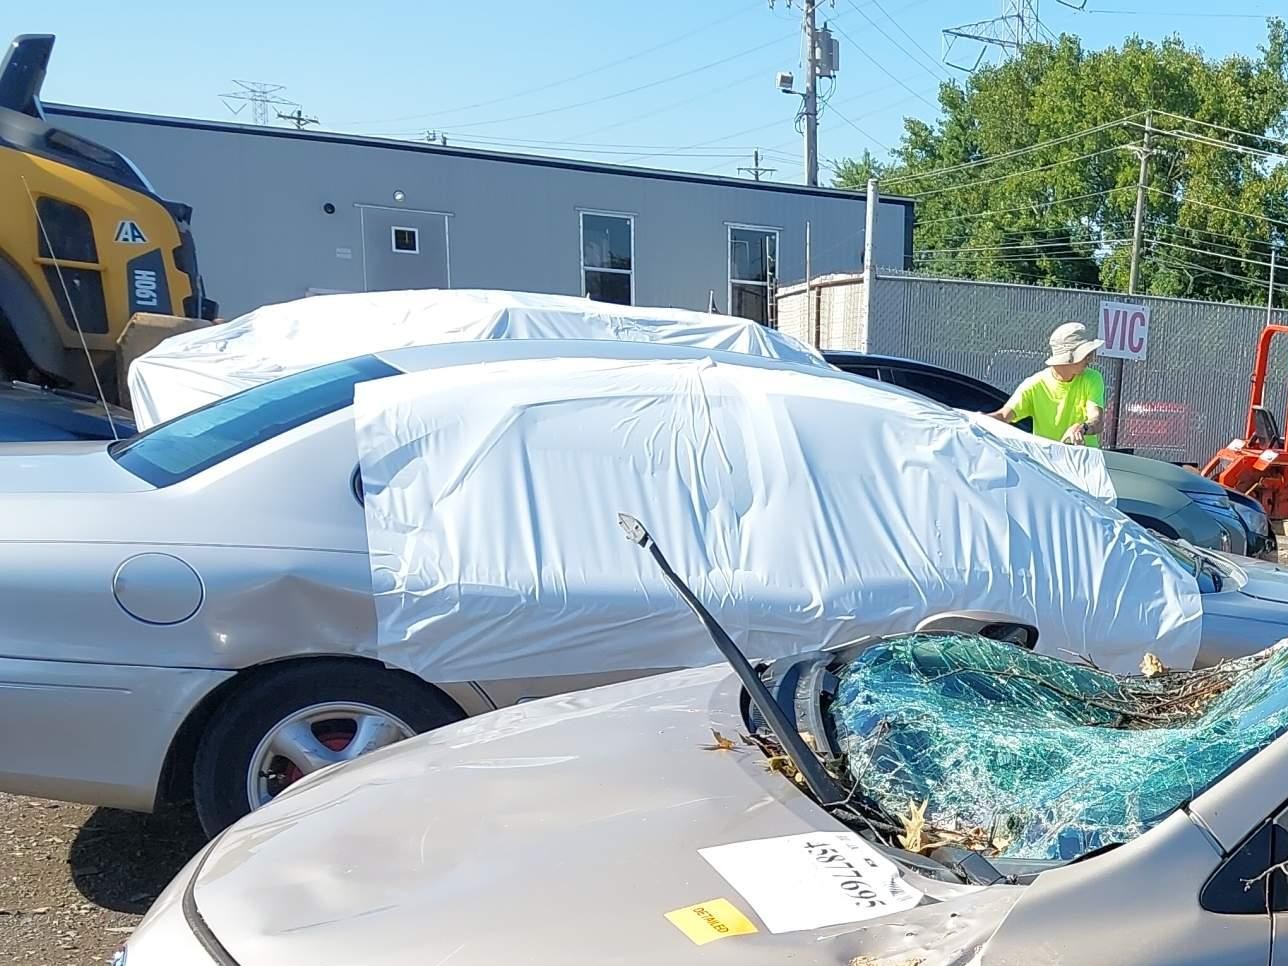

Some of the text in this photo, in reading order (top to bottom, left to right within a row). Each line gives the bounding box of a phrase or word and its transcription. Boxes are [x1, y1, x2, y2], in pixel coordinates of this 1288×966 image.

[134, 270, 157, 305] L90H
[1103, 308, 1146, 353] VIC
[804, 841, 887, 907] 45877695
[693, 907, 729, 933] DETAILED
